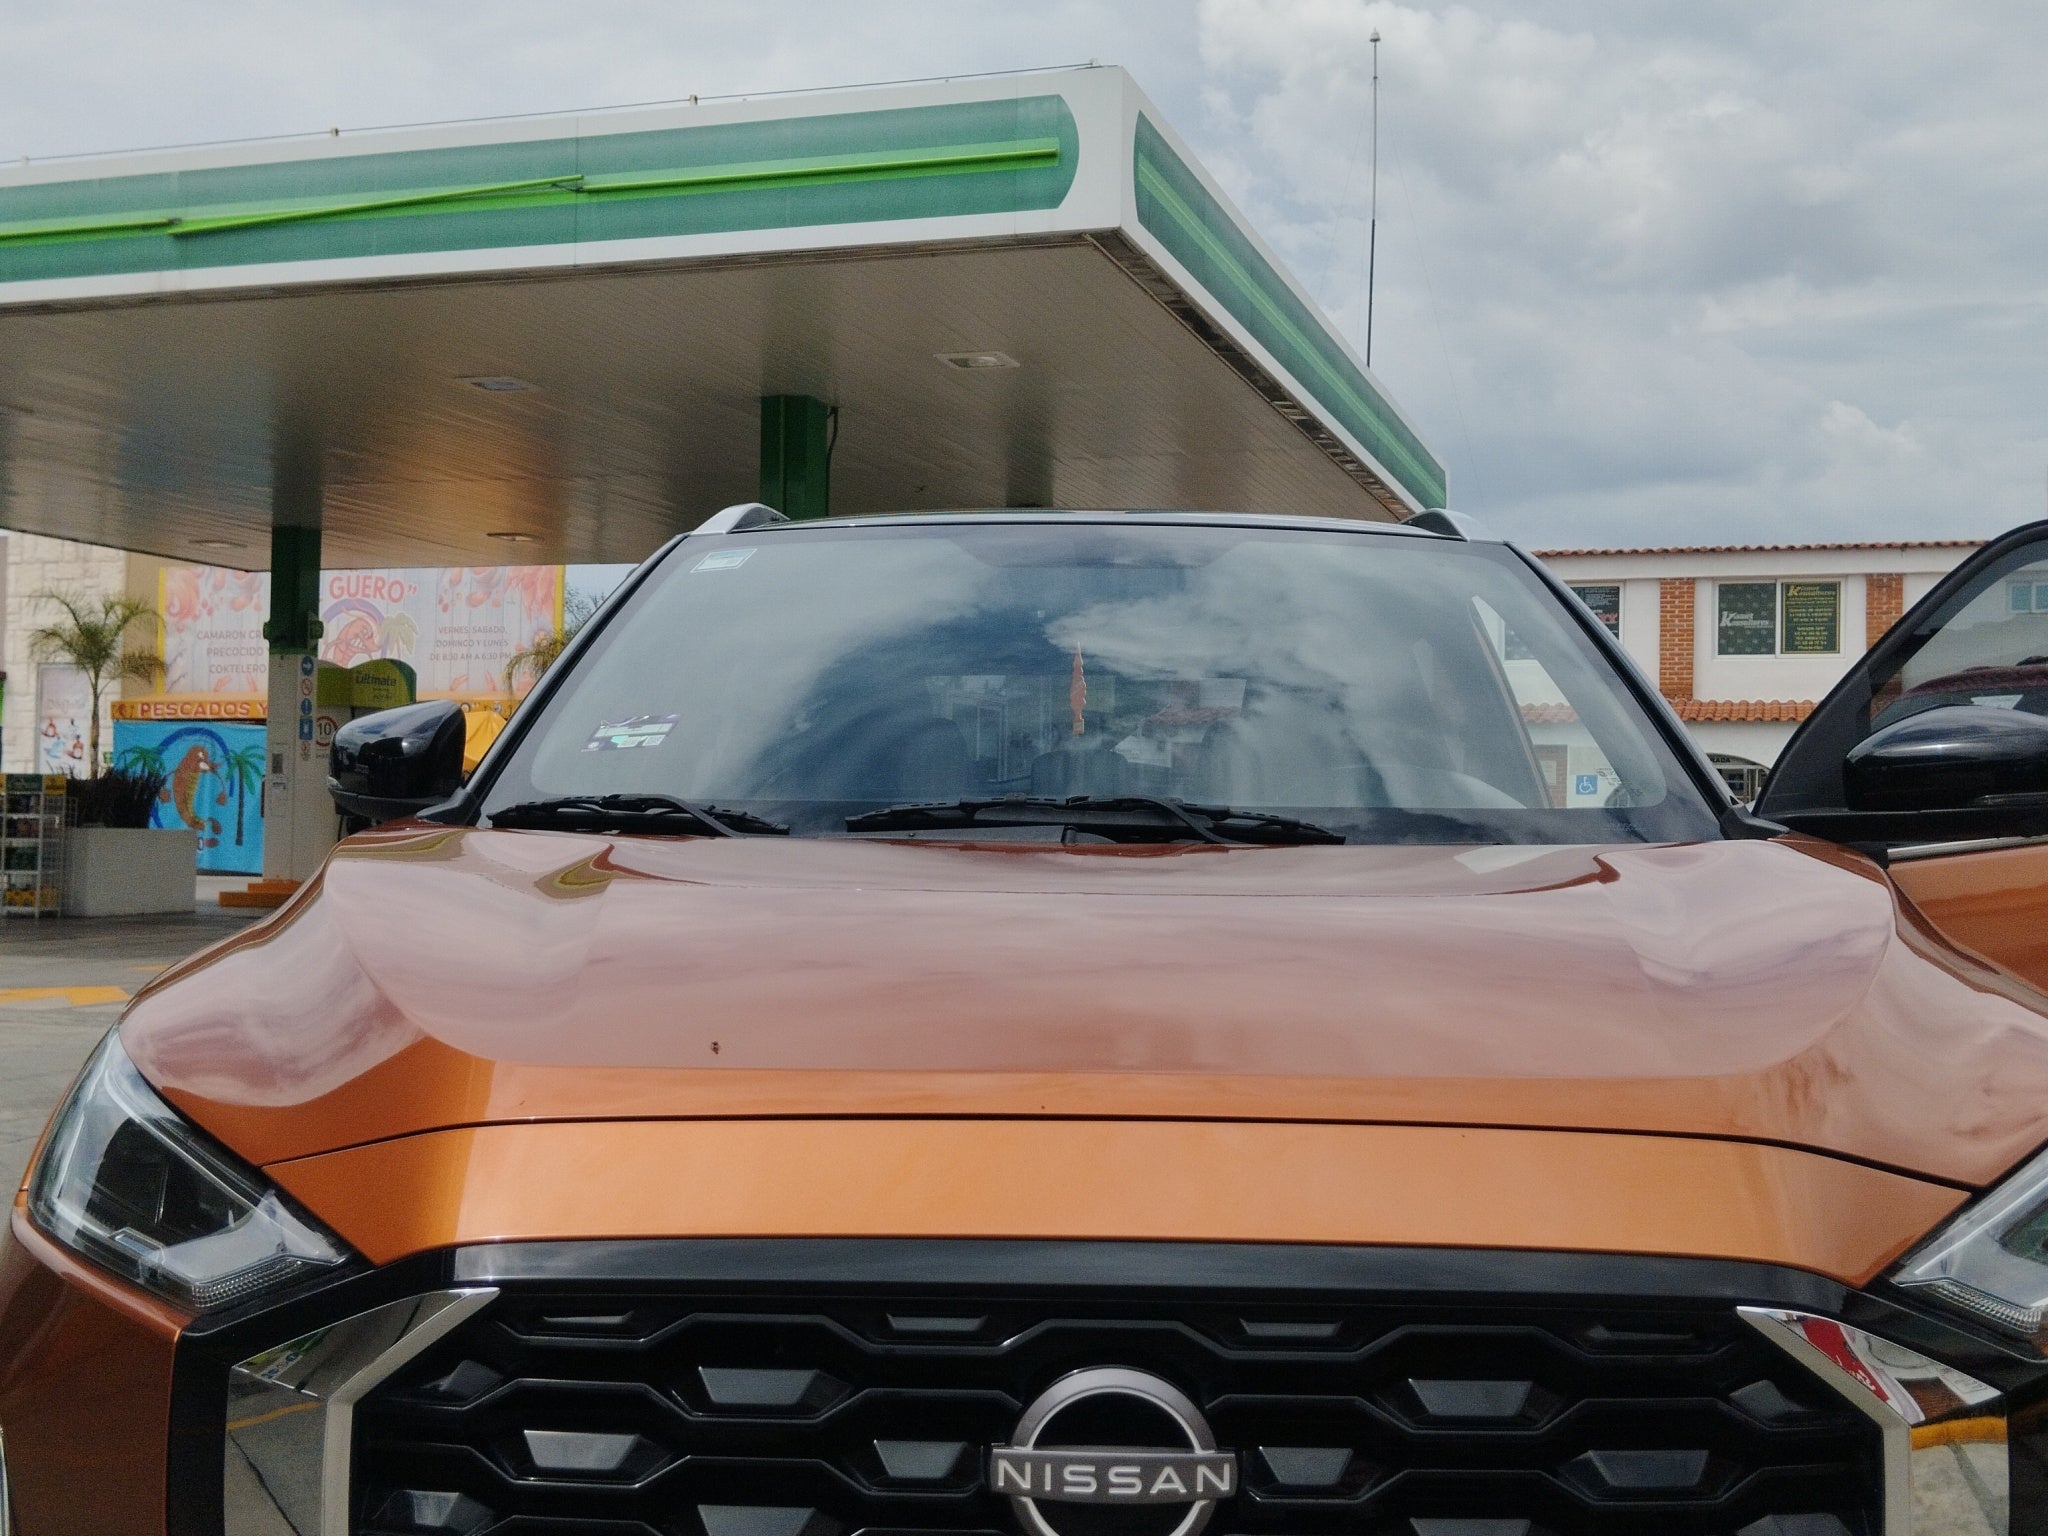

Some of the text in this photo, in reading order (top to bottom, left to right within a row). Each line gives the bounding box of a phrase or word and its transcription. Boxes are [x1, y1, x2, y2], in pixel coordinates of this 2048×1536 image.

[196, 630, 246, 641] CAMARON
[435, 639, 475, 648] DOMINGO
[483, 639, 509, 648] LUNES
[206, 646, 264, 658] PRECOCIDO
[430, 652, 441, 661] DE
[460, 652, 473, 660] AM
[208, 663, 267, 675] COKTELERO
[139, 701, 268, 717] PESCADOS Y
[318, 722, 332, 736] 10
[998, 1458, 1230, 1494] NISSAN
